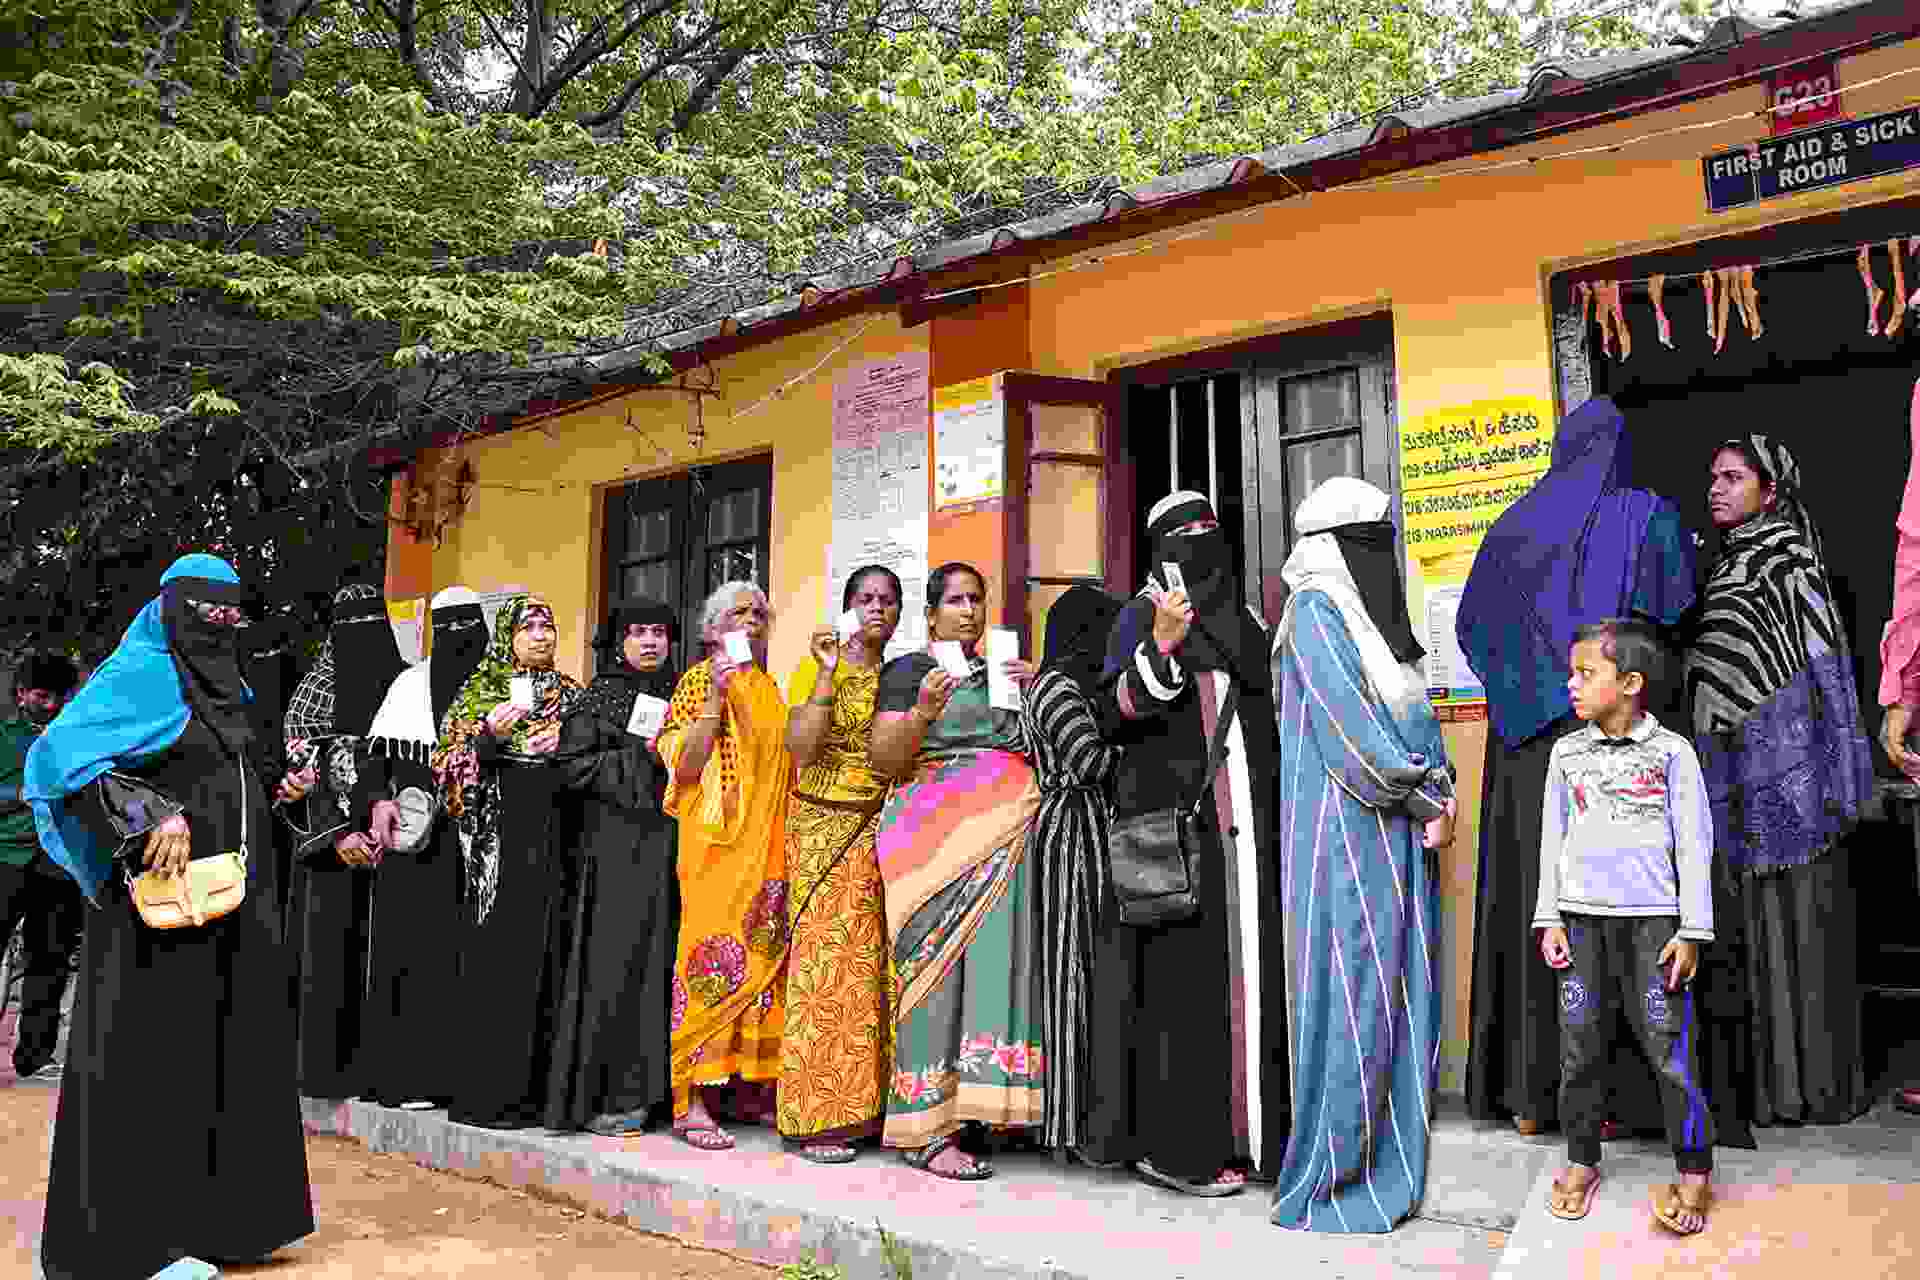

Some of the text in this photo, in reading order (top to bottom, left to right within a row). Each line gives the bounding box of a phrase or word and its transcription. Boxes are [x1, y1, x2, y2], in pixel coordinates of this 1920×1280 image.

[1712, 115, 1915, 180] FIRST AID & SICK
[1778, 155, 1847, 188] ROOM
